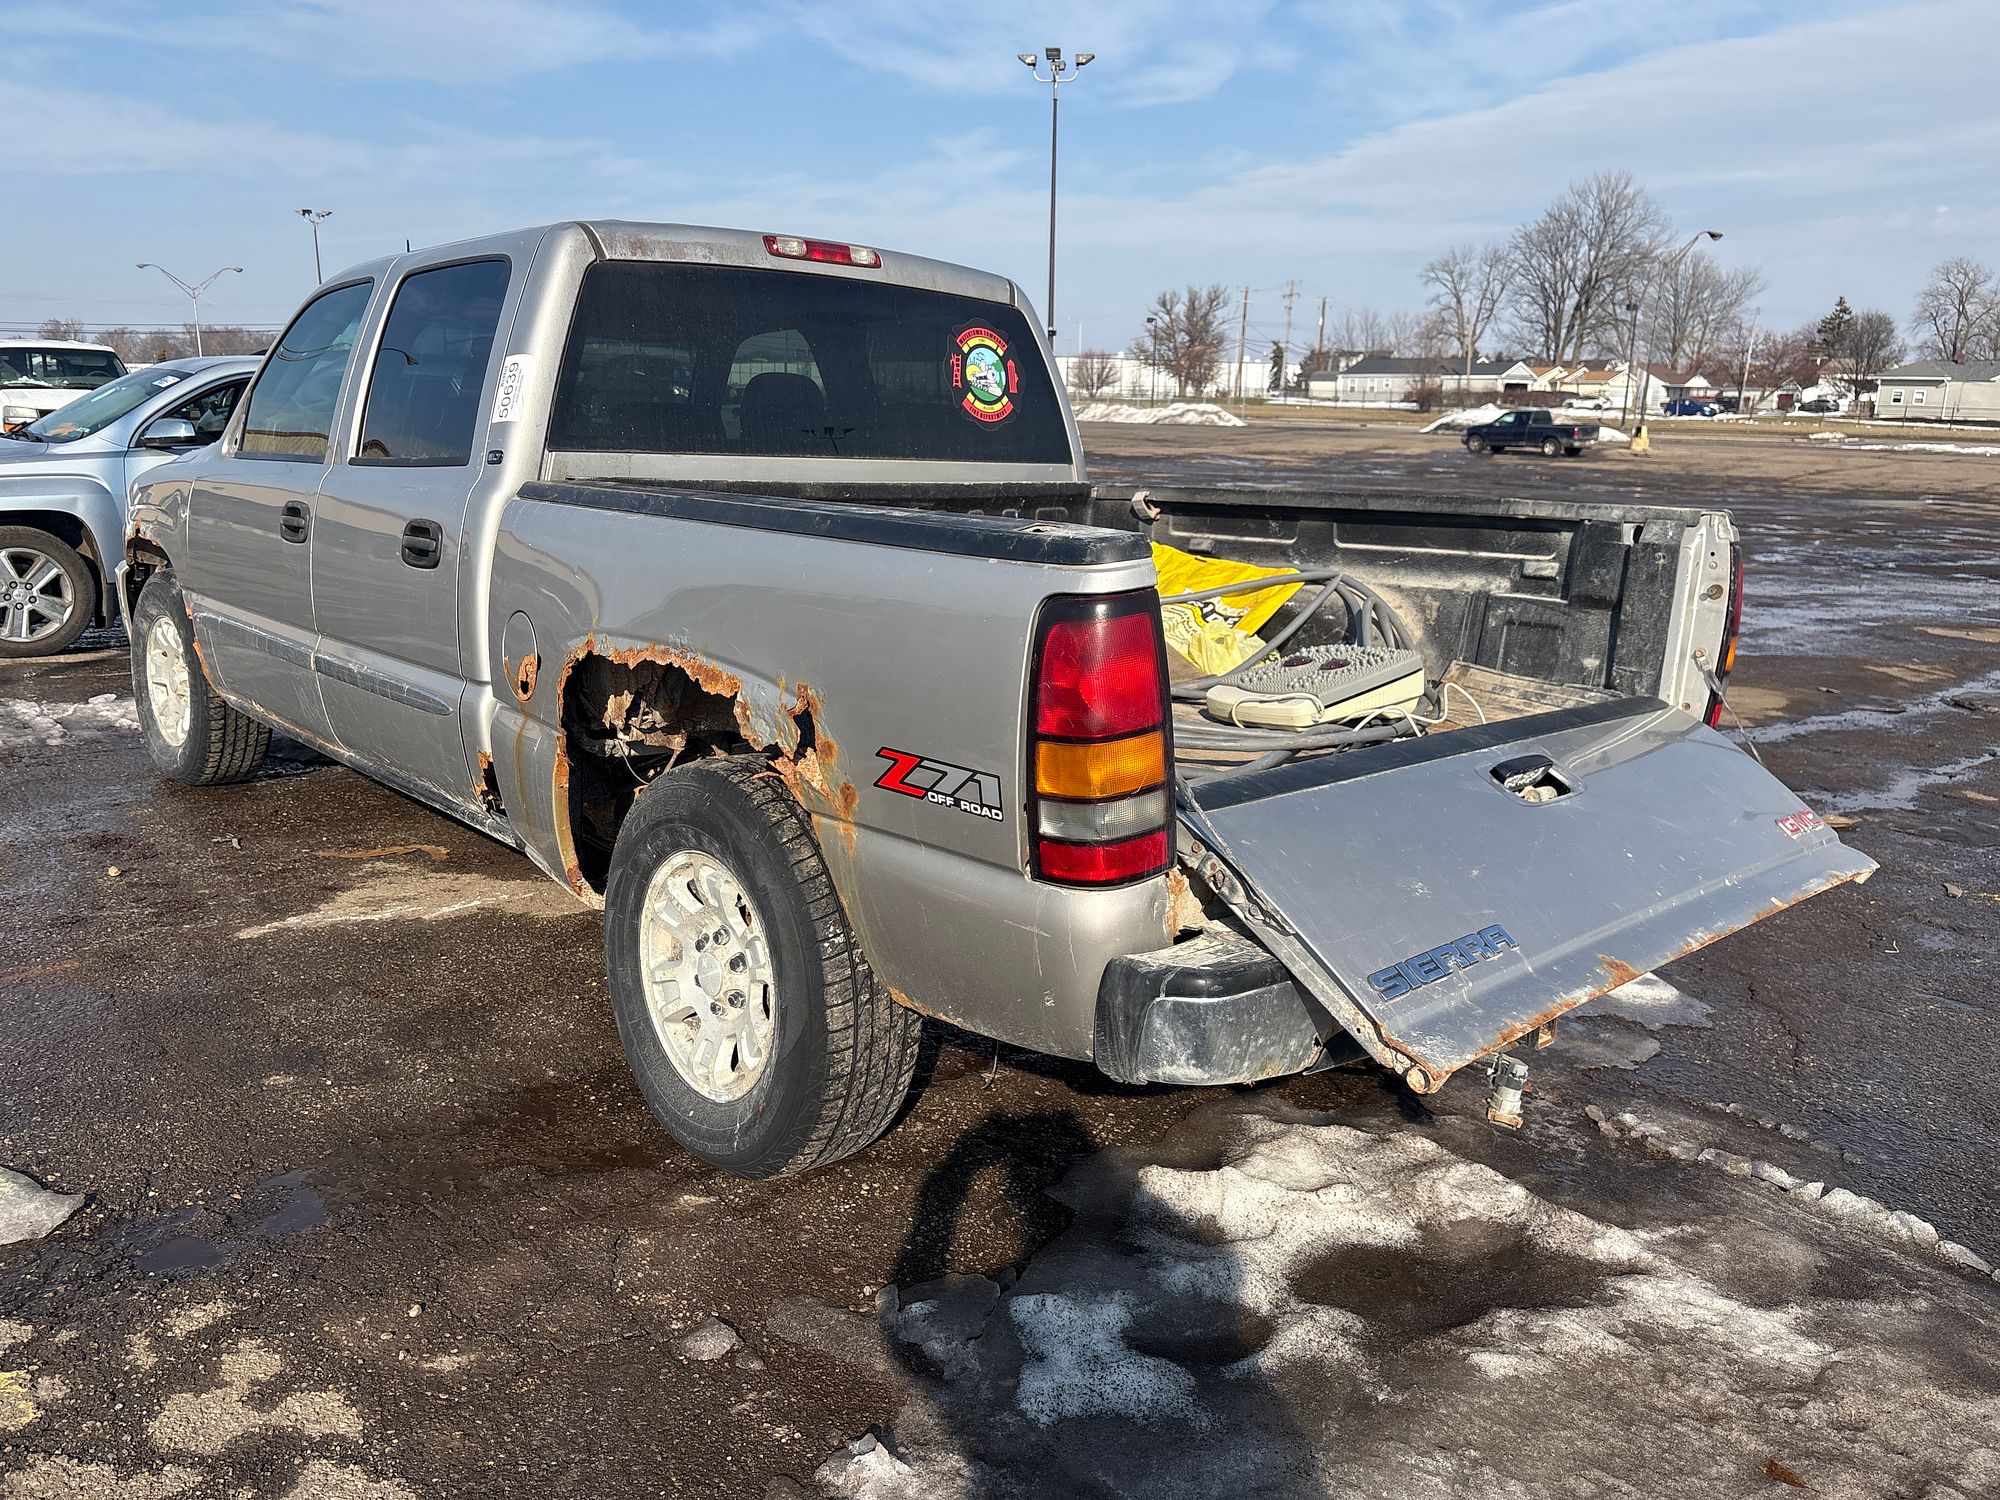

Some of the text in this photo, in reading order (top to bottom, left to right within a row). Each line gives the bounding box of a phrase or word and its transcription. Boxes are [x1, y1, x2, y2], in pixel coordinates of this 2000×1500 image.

[984, 330, 1006, 348] TOWNSHIP
[499, 362, 519, 418] 50639
[969, 406, 979, 417] FIRE
[980, 408, 1007, 421] DEPARTMENT
[873, 746, 1003, 809] Z71
[927, 791, 1003, 821] OFF ROAD
[1775, 810, 1824, 839] GMC
[1367, 923, 1519, 1002] SIERRA
